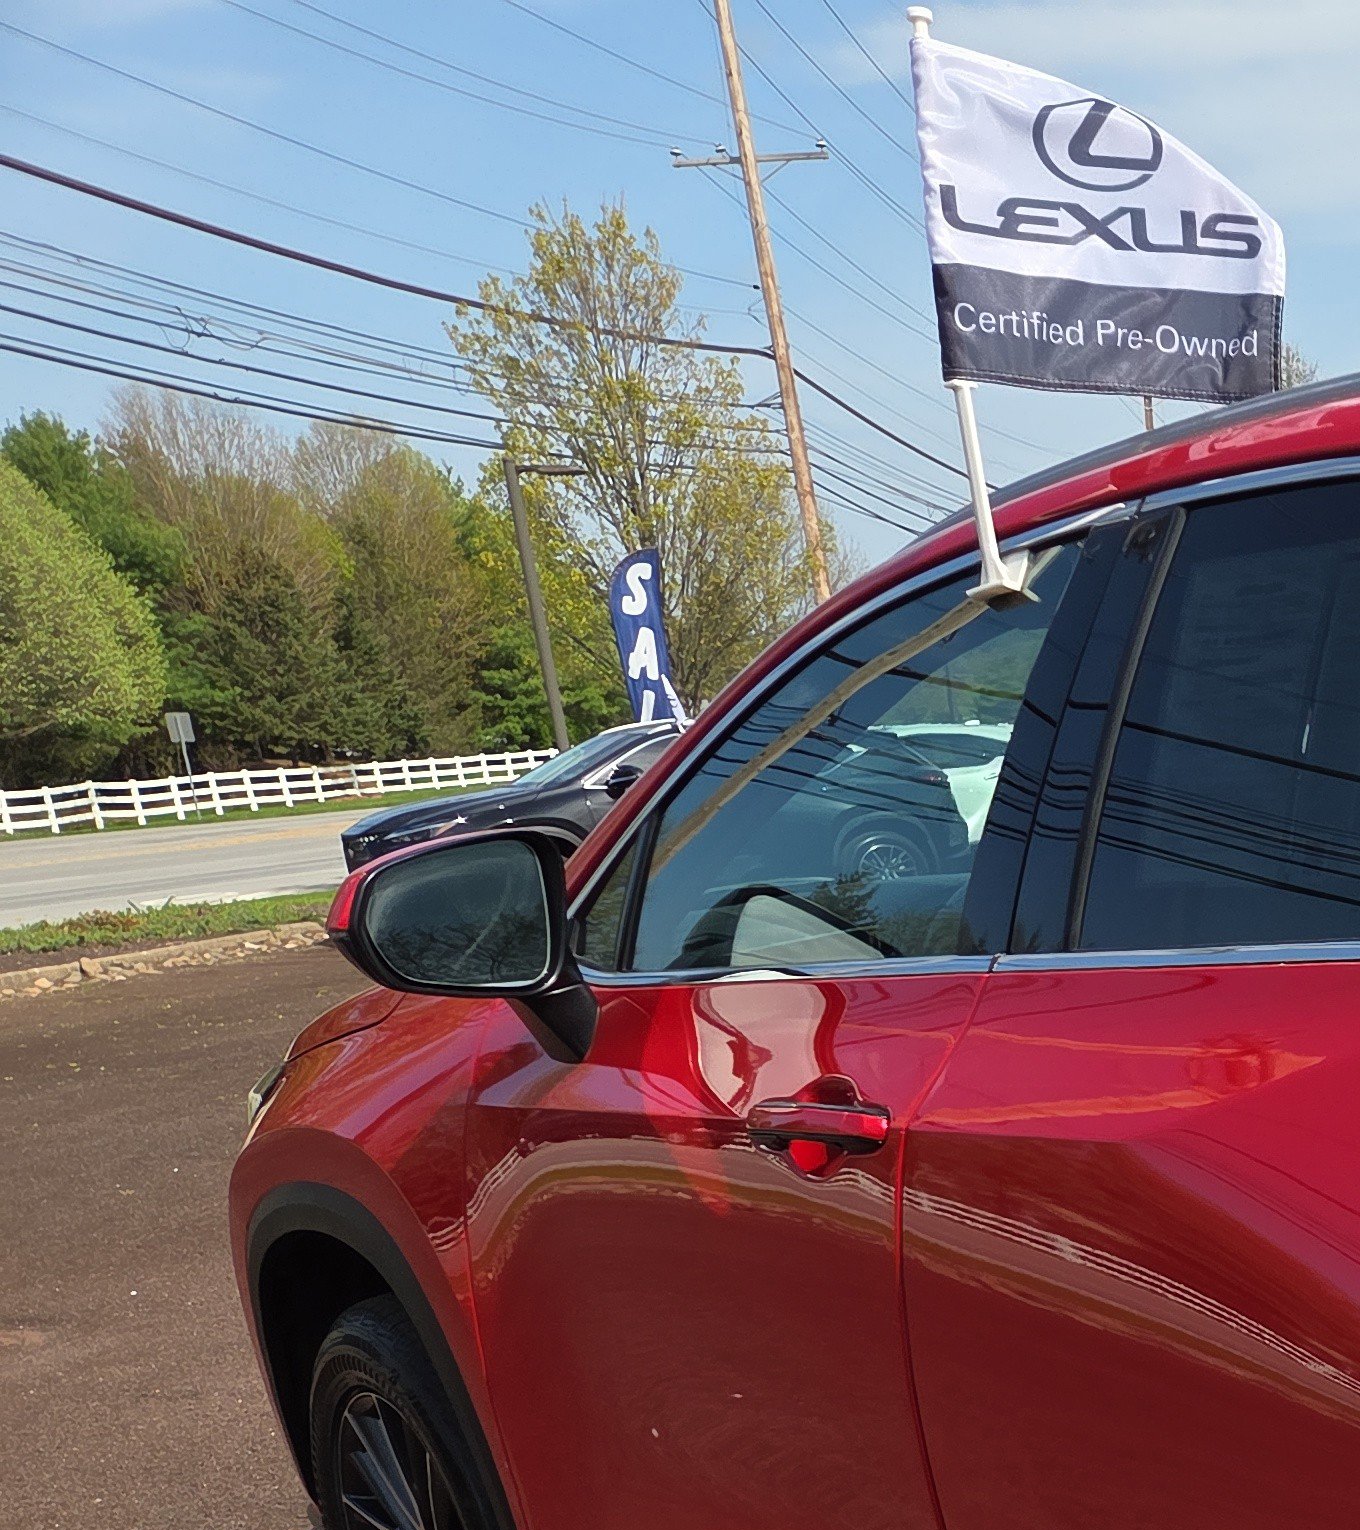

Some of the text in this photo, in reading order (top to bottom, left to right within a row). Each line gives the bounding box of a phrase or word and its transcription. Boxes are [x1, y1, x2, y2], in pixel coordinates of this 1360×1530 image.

[938, 183, 1262, 260] LEXUS
[953, 302, 1259, 360] Certified Pre-Owned
